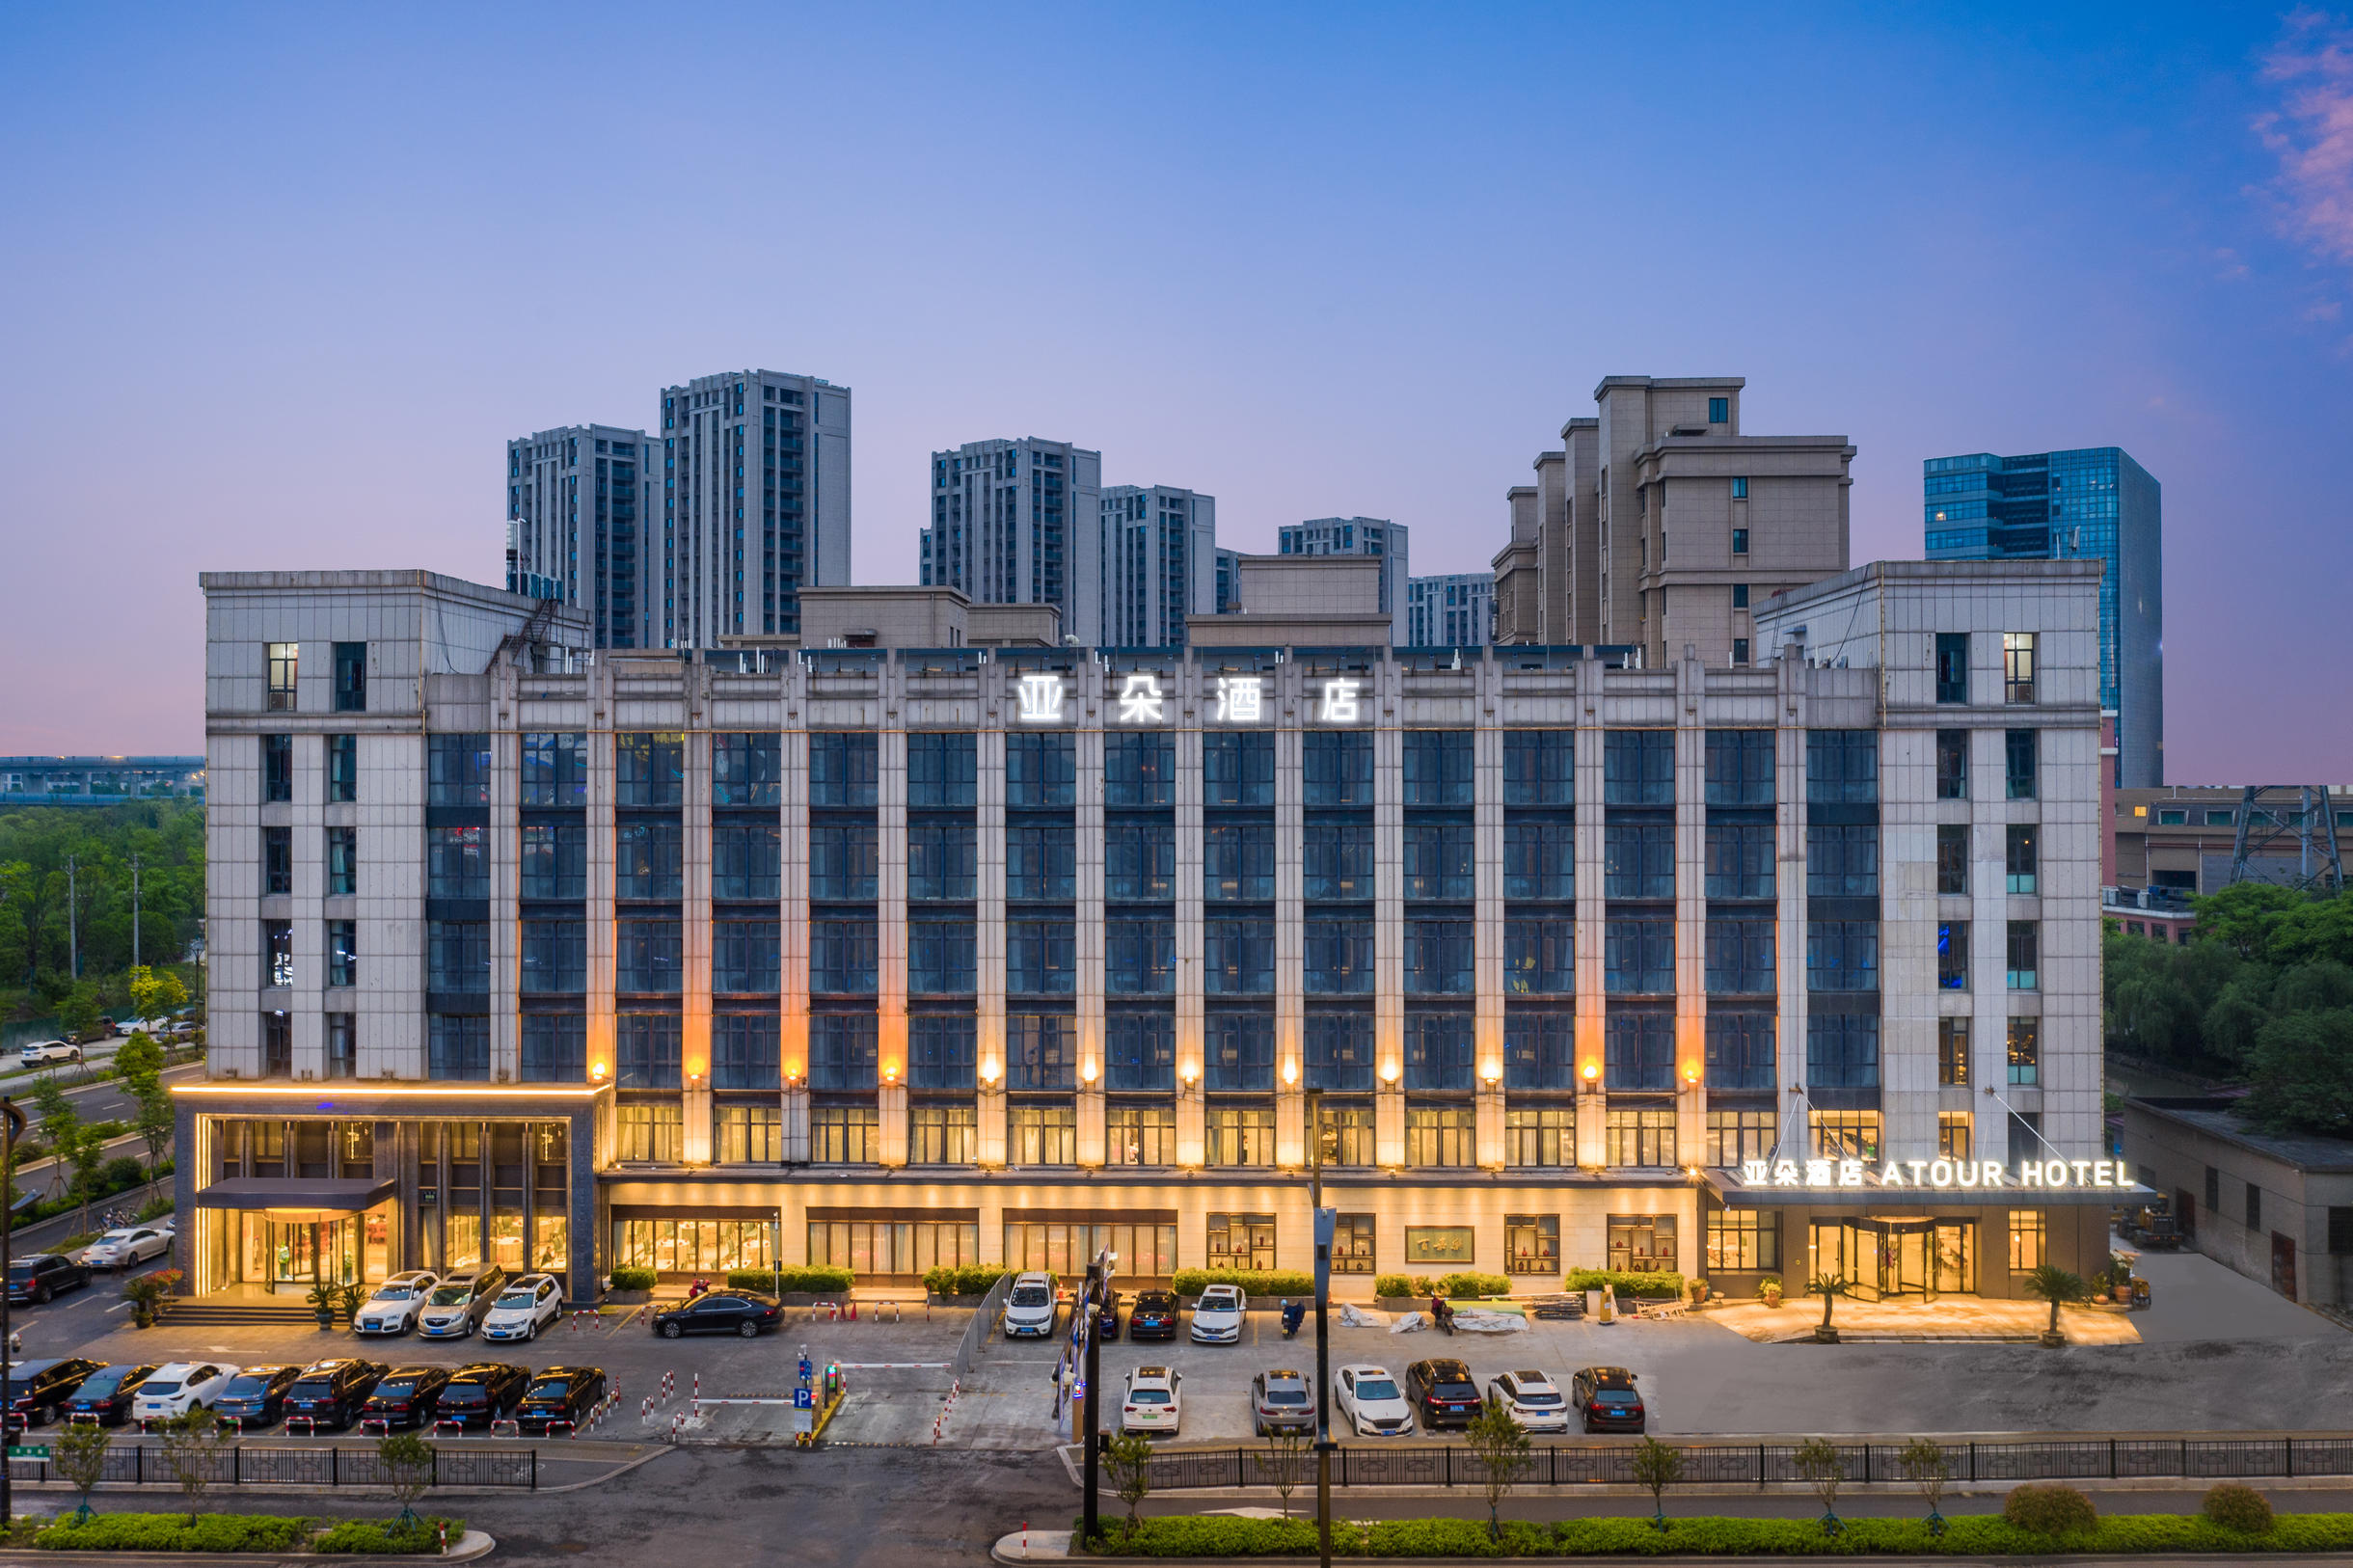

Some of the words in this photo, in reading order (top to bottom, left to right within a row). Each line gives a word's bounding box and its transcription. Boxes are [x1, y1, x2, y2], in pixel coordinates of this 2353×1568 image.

[1018, 676, 1360, 721] 亚朵酒店
[1744, 1160, 1863, 1186] 亚朵酒店
[1880, 1160, 2003, 1187] ATOUR
[2022, 1160, 2135, 1187] HOTEL
[798, 1391, 808, 1407] P
